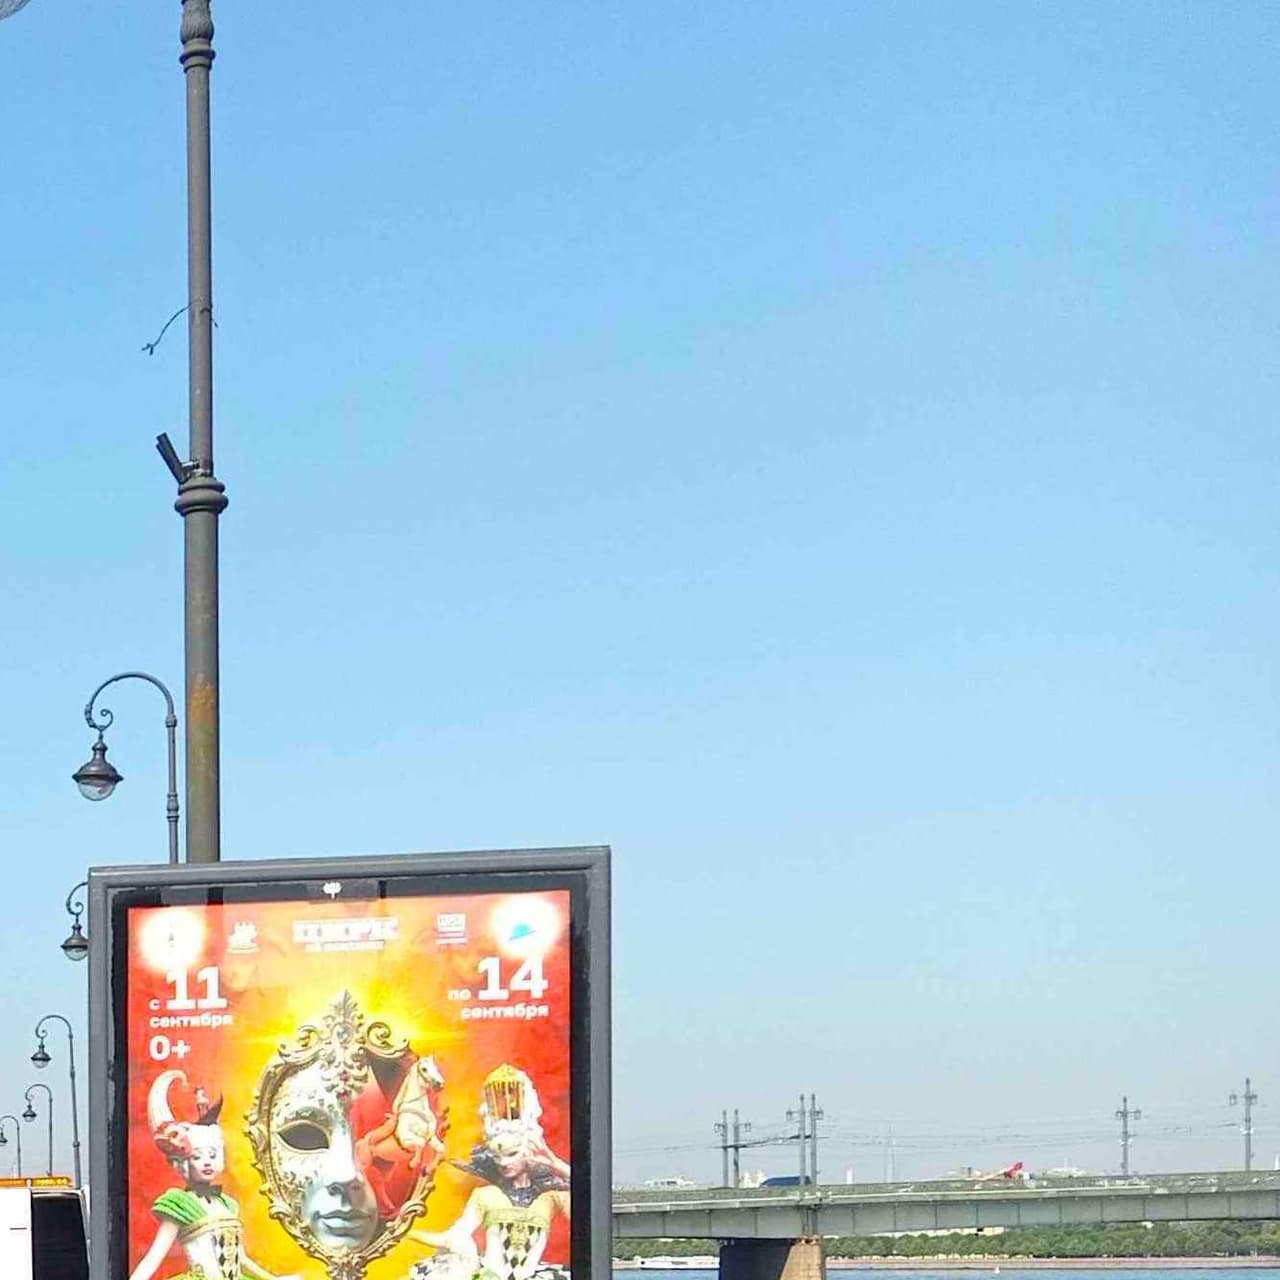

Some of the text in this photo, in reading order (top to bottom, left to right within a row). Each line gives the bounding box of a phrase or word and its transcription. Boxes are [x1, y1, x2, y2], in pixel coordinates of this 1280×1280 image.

[149, 966, 228, 1011] с 11
[447, 956, 550, 1001] по 14
[149, 1012, 234, 1030] сентября
[461, 1002, 550, 1021] сентября
[149, 1034, 191, 1062] 0+
